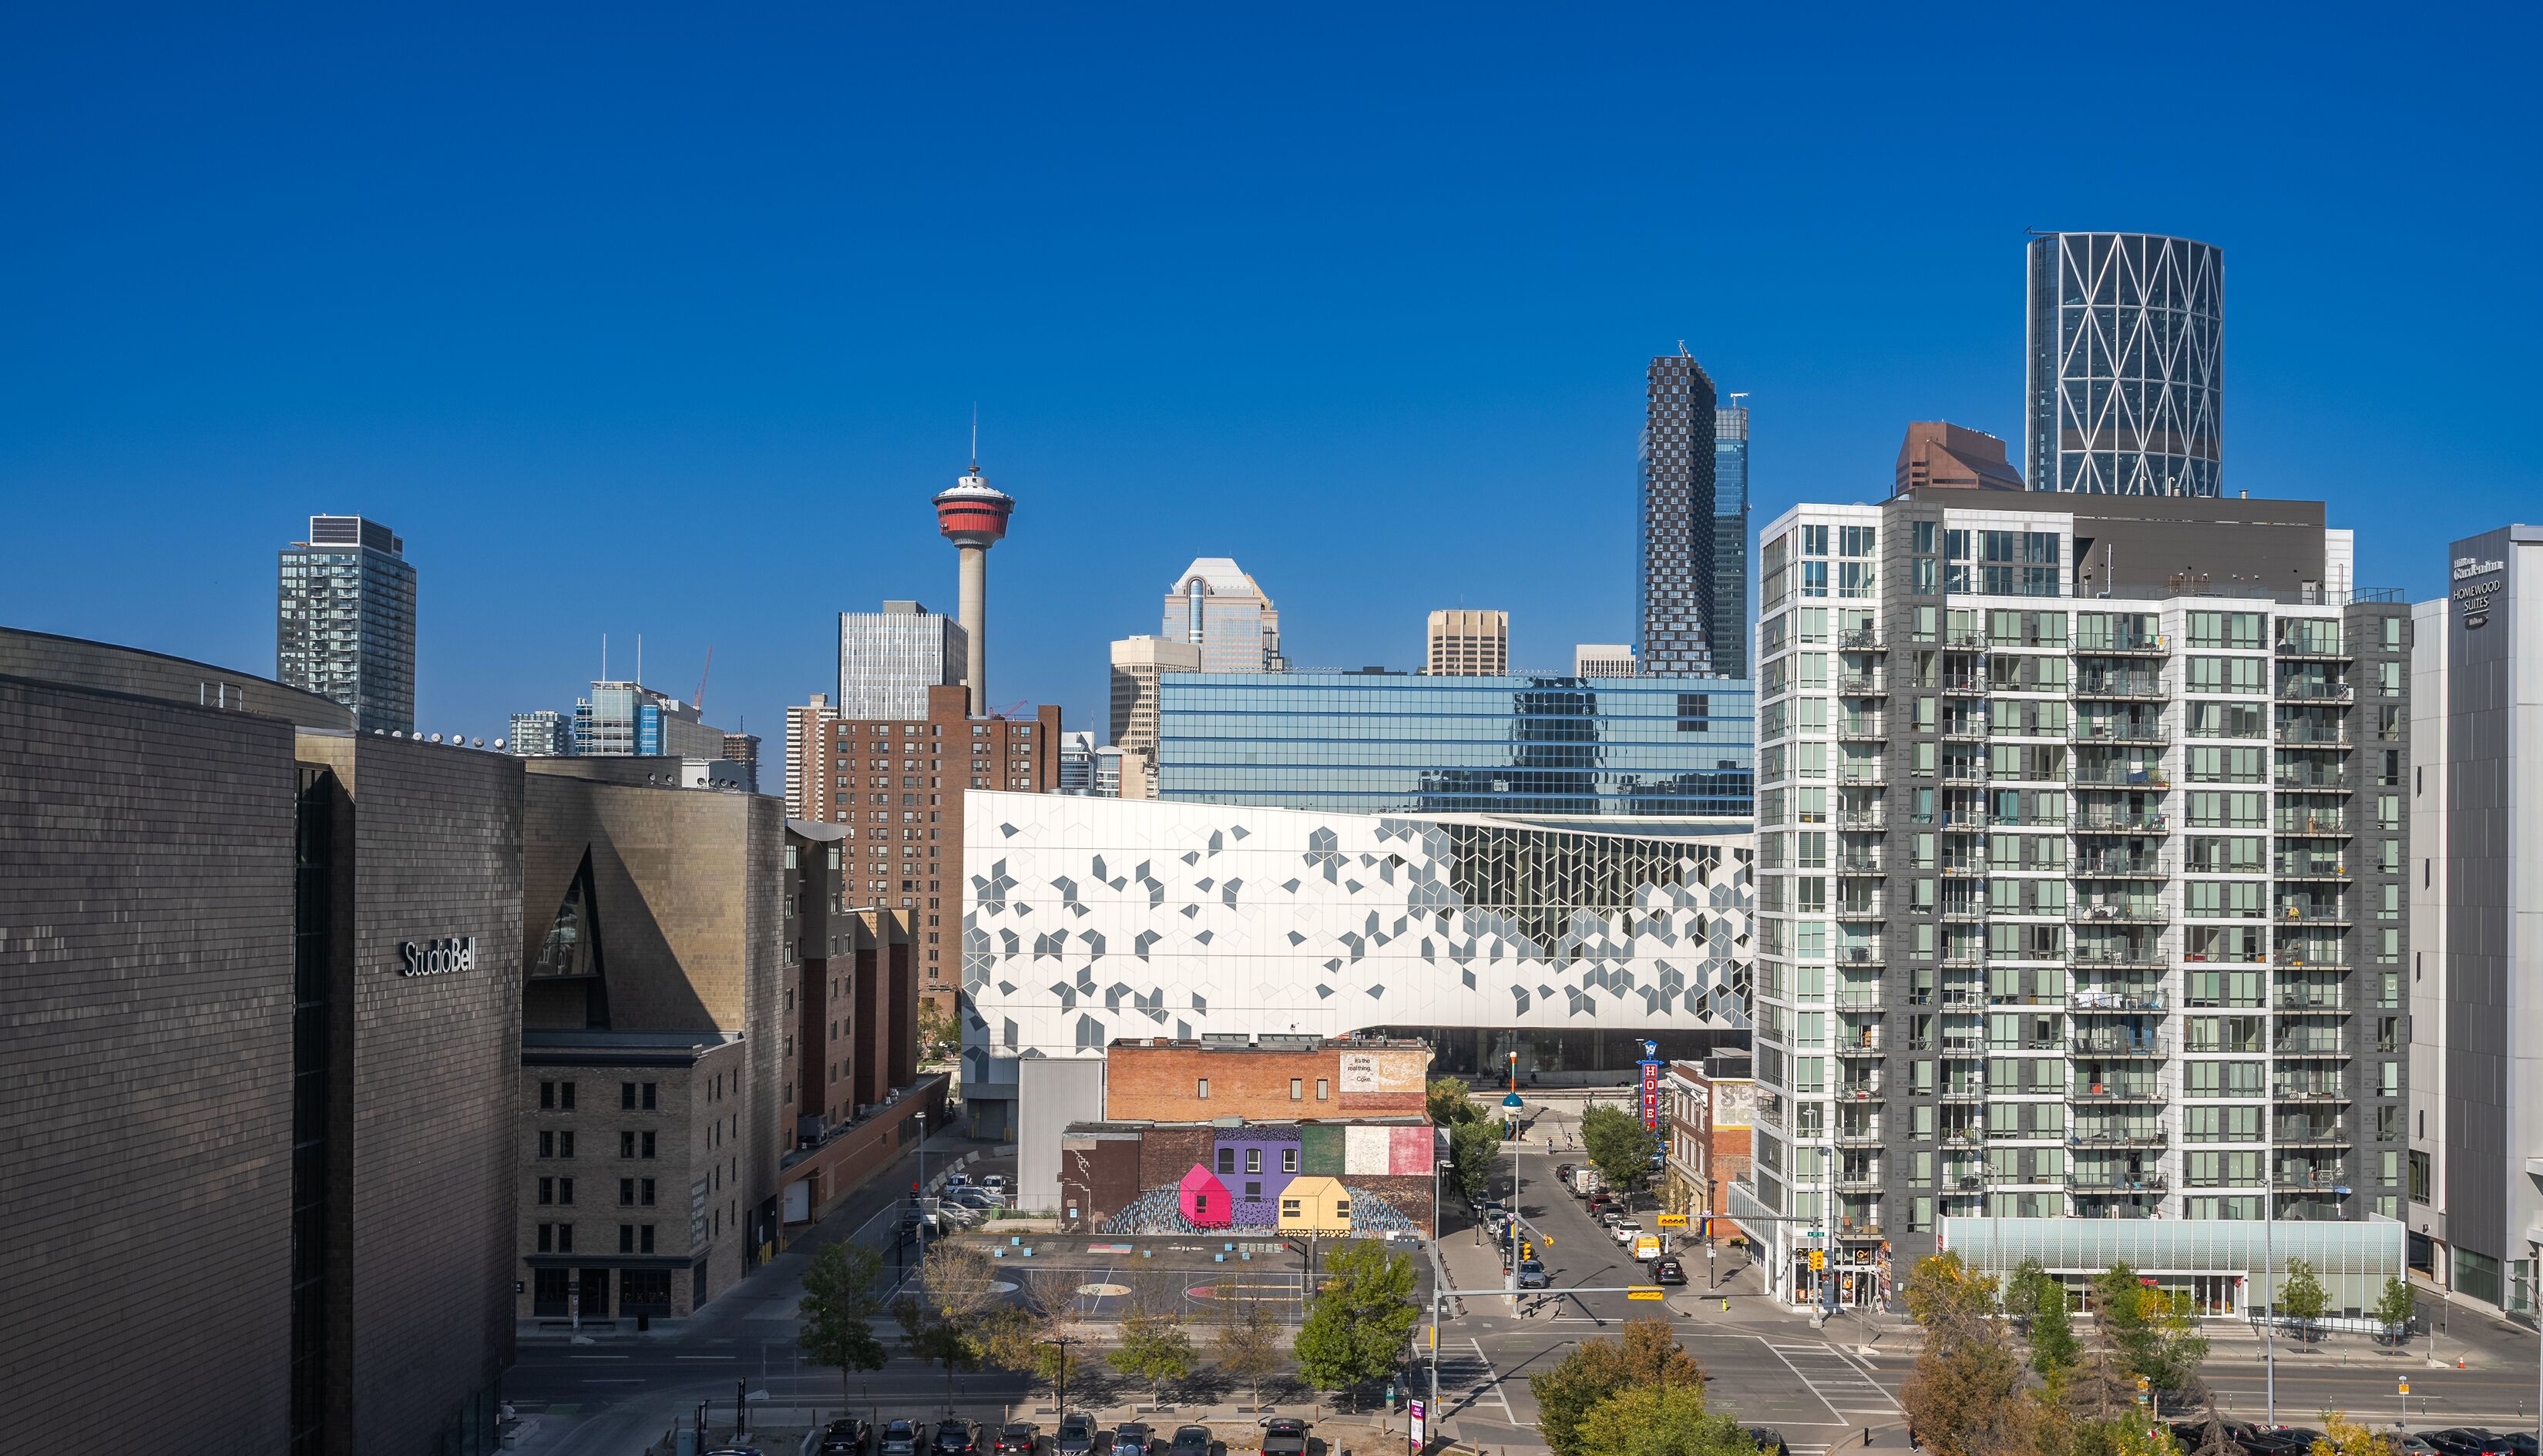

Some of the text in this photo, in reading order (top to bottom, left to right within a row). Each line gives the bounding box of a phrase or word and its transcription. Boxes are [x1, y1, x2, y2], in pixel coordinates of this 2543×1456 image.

[2453, 580, 2500, 601] HOMEWOOD
[2464, 596, 2489, 612] SUITES
[2469, 617, 2483, 626] Hilton
